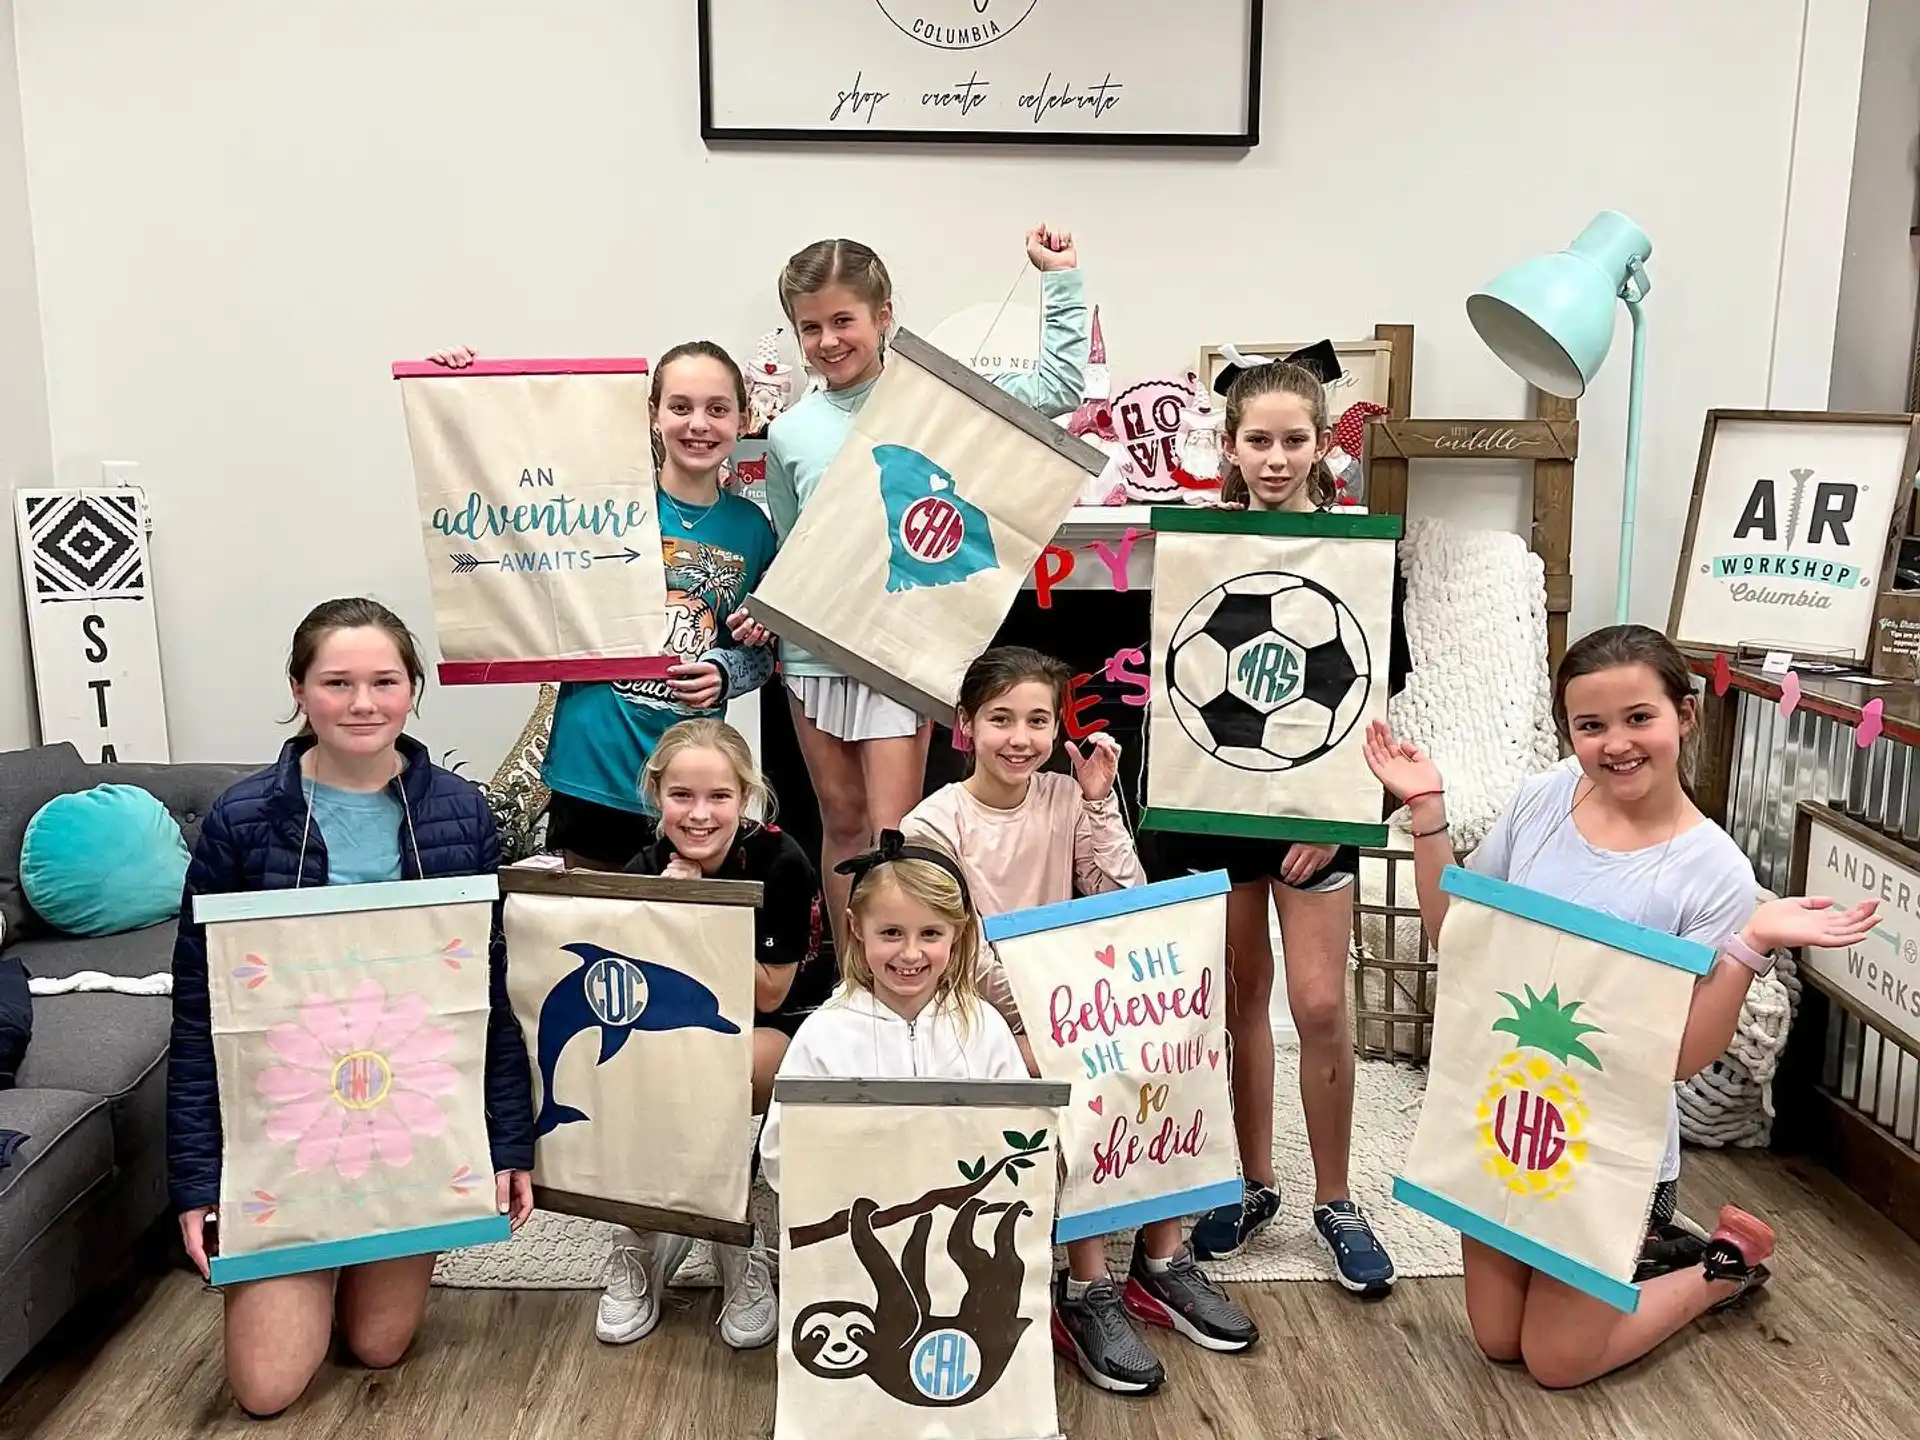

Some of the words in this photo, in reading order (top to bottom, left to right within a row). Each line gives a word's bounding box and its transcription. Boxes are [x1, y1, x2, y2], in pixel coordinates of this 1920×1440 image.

[912, 18, 1001, 44] COLUMBIA
[829, 71, 890, 123] shop
[921, 71, 990, 118] create
[1018, 72, 1123, 123] celebrate
[970, 356, 1001, 367] YOU
[1430, 428, 1526, 451] cuddle
[519, 467, 554, 487] AN
[432, 491, 648, 540] adventure
[499, 550, 592, 572] AWAITS
[1721, 556, 1851, 583] WORKSHOP
[1730, 582, 1833, 609] Columbia
[1237, 642, 1299, 704] MRS
[1127, 941, 1186, 982] SHE
[1050, 967, 1212, 1047] believed
[1082, 1040, 1129, 1080] SHE
[1141, 1033, 1205, 1075] COULD
[1092, 1115, 1145, 1184] she
[1148, 1109, 1208, 1166] did
[1494, 1090, 1567, 1171] LHG
